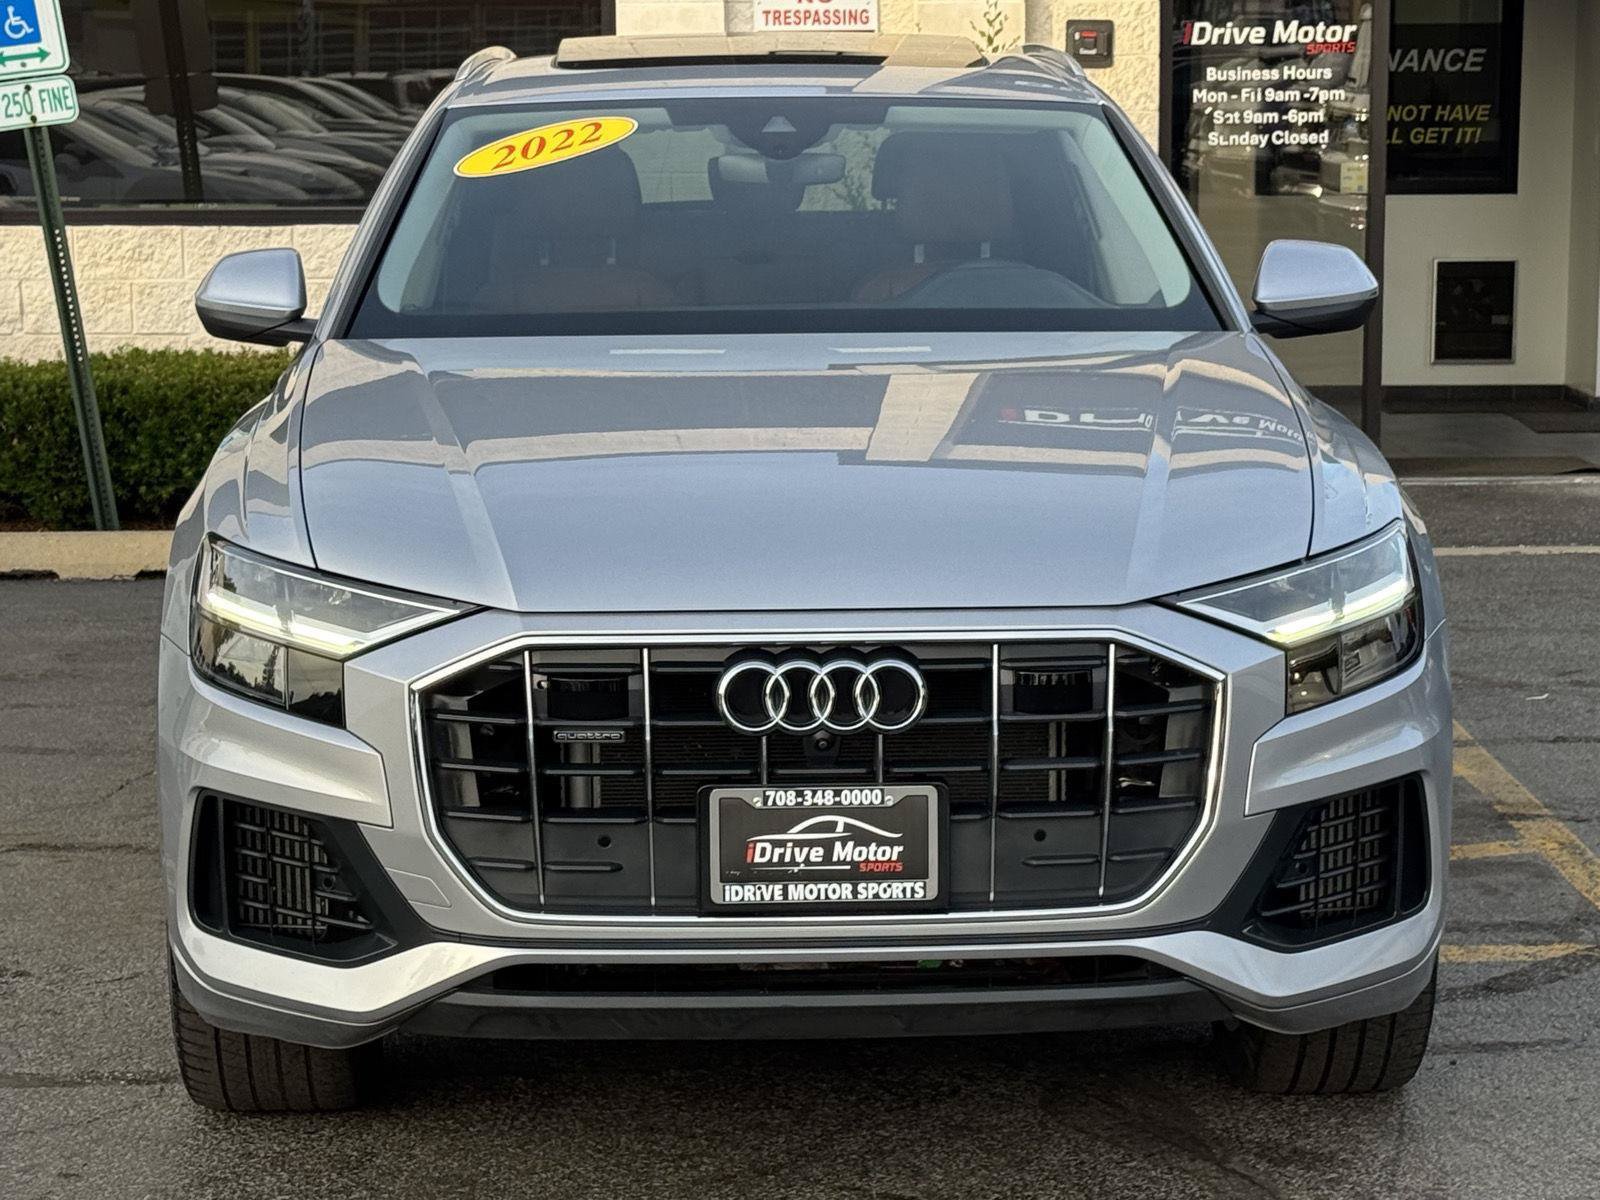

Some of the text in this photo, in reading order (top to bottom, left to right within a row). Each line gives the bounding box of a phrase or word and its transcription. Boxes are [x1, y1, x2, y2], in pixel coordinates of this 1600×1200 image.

[762, 9, 870, 26] TRESPASSING
[1272, 20, 1358, 44] Motor
[1306, 42, 1356, 55] SPORTS
[1206, 66, 1333, 81] Business Hours
[38, 87, 74, 113] FINE
[1192, 89, 1228, 103] Mon
[1264, 88, 1300, 102] 9am
[1213, 110, 1241, 124] Sat
[1243, 110, 1279, 124] 9am
[1387, 104, 1491, 122] NOT HAVE
[1208, 130, 1329, 148] Sunday Closed
[1410, 127, 1453, 144] GET
[1455, 127, 1481, 143] IT!
[491, 122, 602, 171] 2022
[557, 732, 620, 741] quattro
[765, 789, 882, 806] 708-348-0000
[746, 841, 904, 863] iDrive Motor
[859, 862, 903, 872] SPORTS
[788, 883, 852, 900] MOTOR
[857, 881, 925, 899] SPORTS
